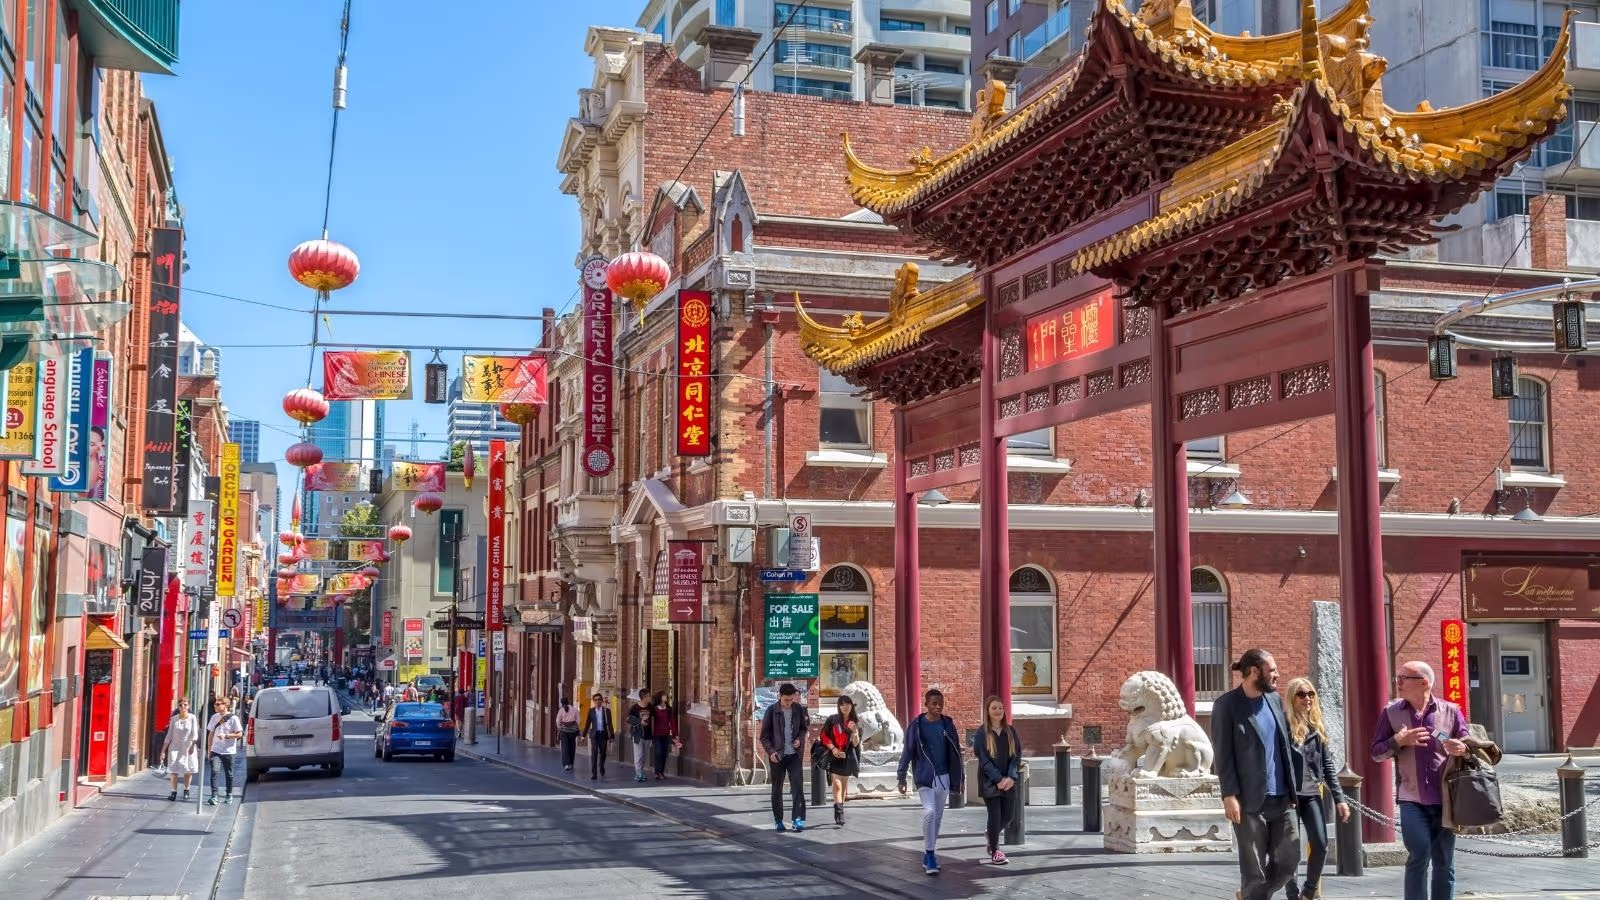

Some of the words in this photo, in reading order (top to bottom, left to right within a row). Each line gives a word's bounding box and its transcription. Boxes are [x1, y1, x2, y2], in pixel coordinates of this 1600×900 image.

[592, 291, 606, 366] ORIENTAL
[43, 359, 57, 420] anguage
[592, 374, 606, 443] GOURMET
[682, 334, 705, 446] 北京同仁堂
[43, 423, 57, 469] School
[144, 463, 172, 472] Japanese
[222, 528, 235, 583] GARDEN
[492, 535, 501, 564] CHINA
[141, 568, 161, 612] shine
[492, 565, 500, 579] OF
[1536, 586, 1575, 597] melbourne
[491, 584, 500, 624] EMPRESS
[769, 604, 789, 613] FOR
[791, 604, 814, 613] SALE
[769, 615, 792, 629] 出售
[825, 631, 856, 639] Chinese
[1447, 647, 1462, 709] 北京同仁
